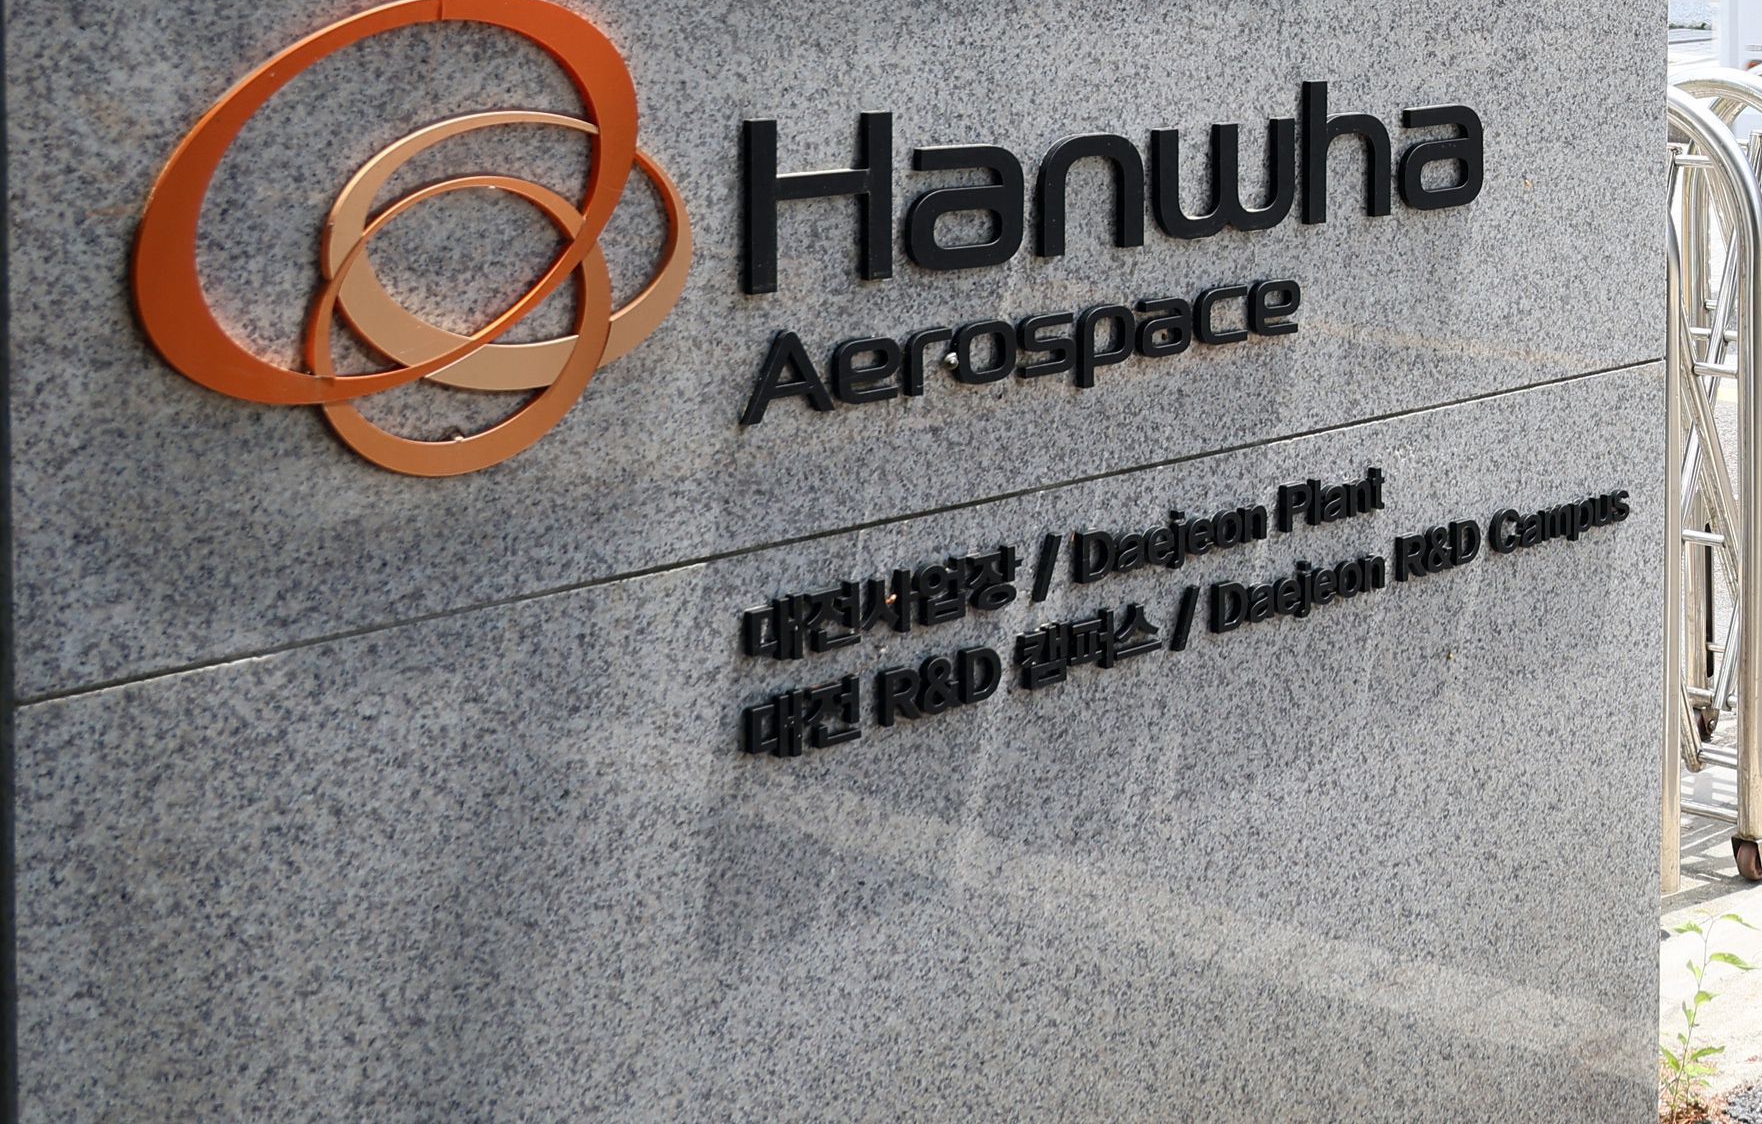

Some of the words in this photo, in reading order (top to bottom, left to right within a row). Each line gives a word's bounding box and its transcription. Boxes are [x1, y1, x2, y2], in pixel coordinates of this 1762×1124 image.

[743, 80, 1485, 294] Hanwha
[741, 278, 1301, 426] Aerospace
[743, 544, 1022, 661] 대전사업장
[1074, 502, 1267, 585] Daejeon
[1278, 467, 1386, 533] Plant
[744, 674, 862, 758] 대전
[878, 645, 1002, 727] R&D
[1015, 602, 1163, 690] 캠퍼스
[1211, 553, 1386, 634] Daejeon
[1395, 518, 1482, 582] R&D
[1488, 489, 1631, 555] Campus
